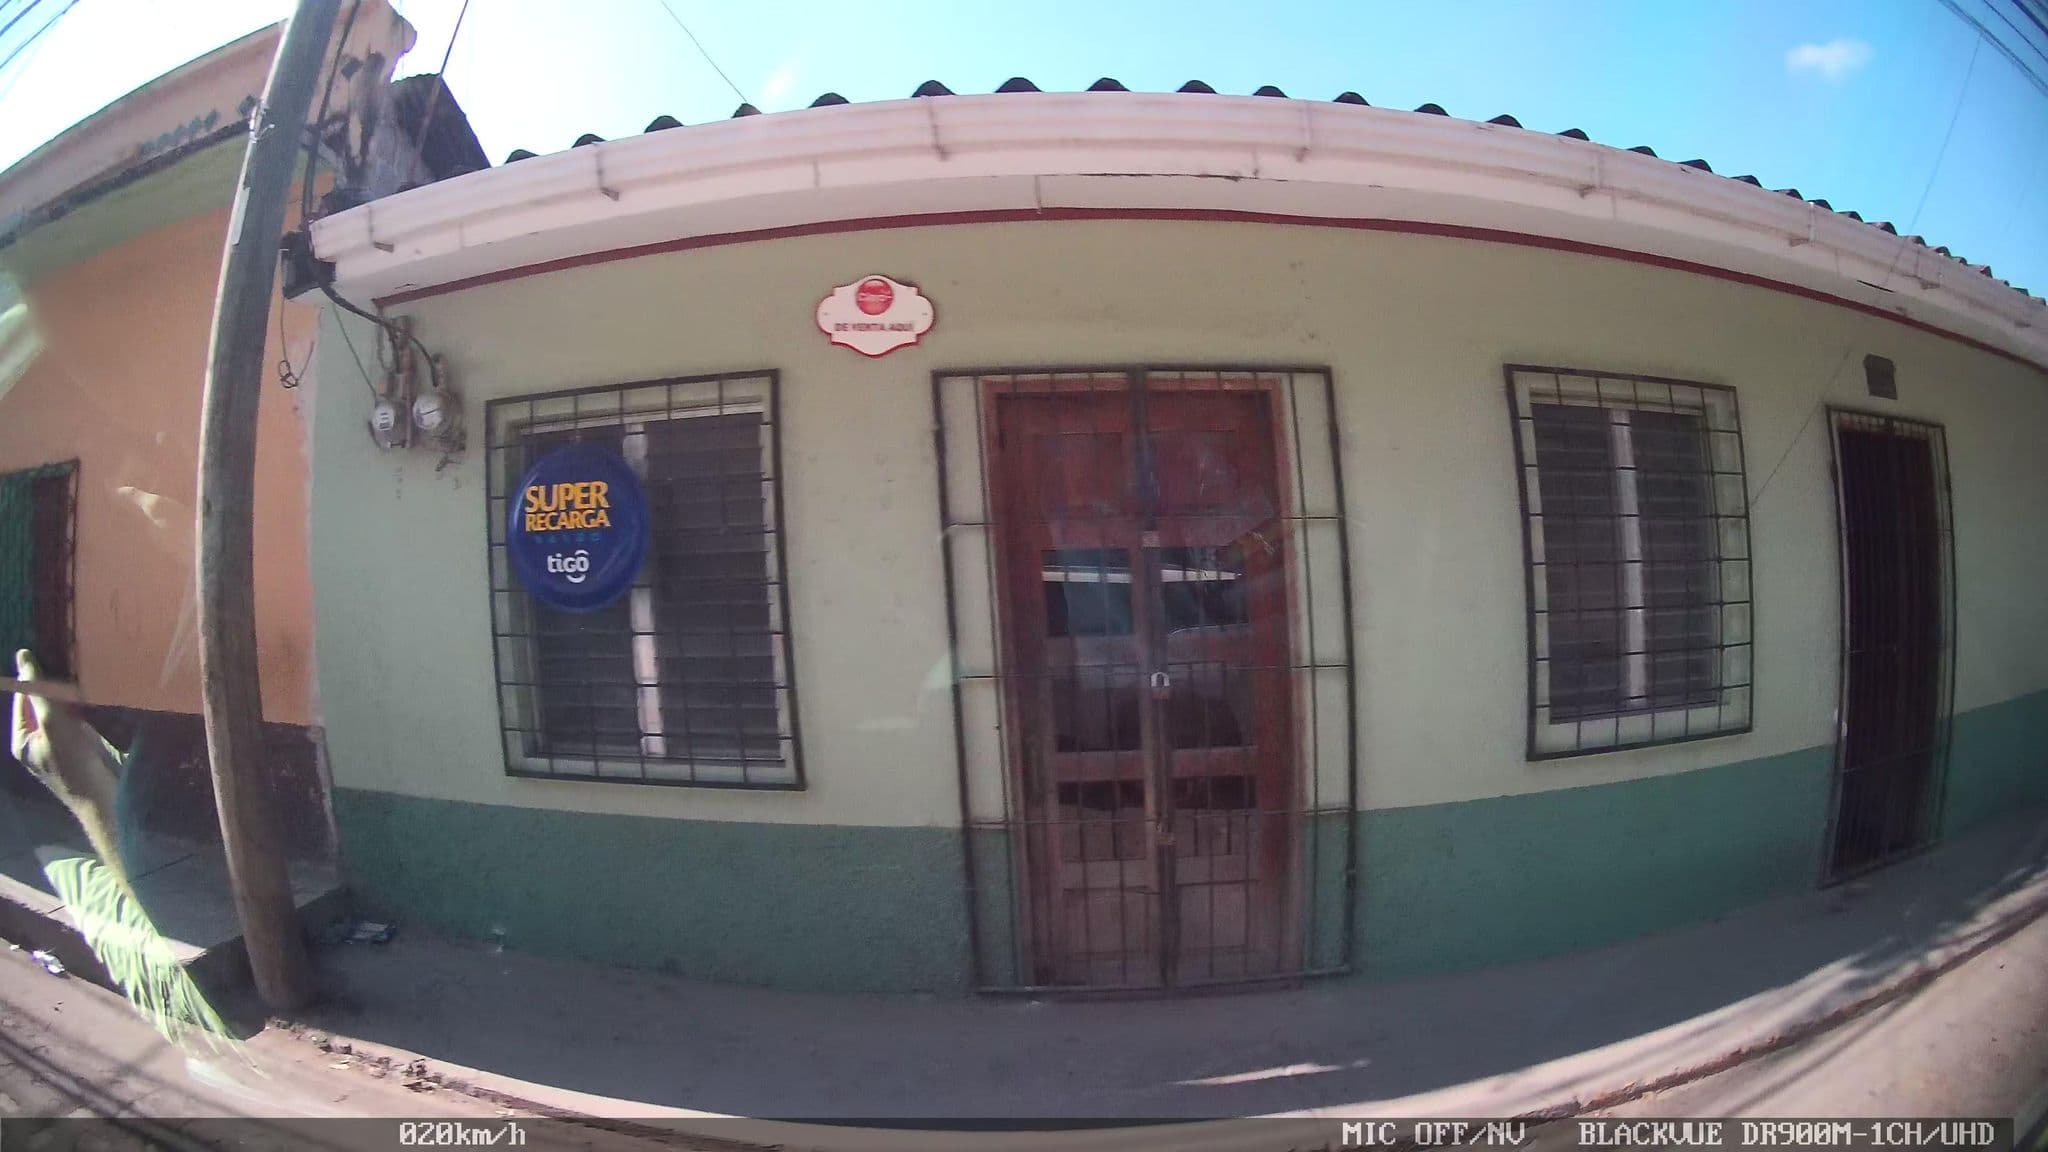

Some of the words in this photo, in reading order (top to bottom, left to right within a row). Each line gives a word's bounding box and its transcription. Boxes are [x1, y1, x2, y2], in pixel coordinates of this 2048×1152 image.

[834, 322, 849, 332] DE
[851, 322, 886, 332] VENTA
[524, 480, 611, 513] SUPER
[525, 509, 612, 532] RECARGA
